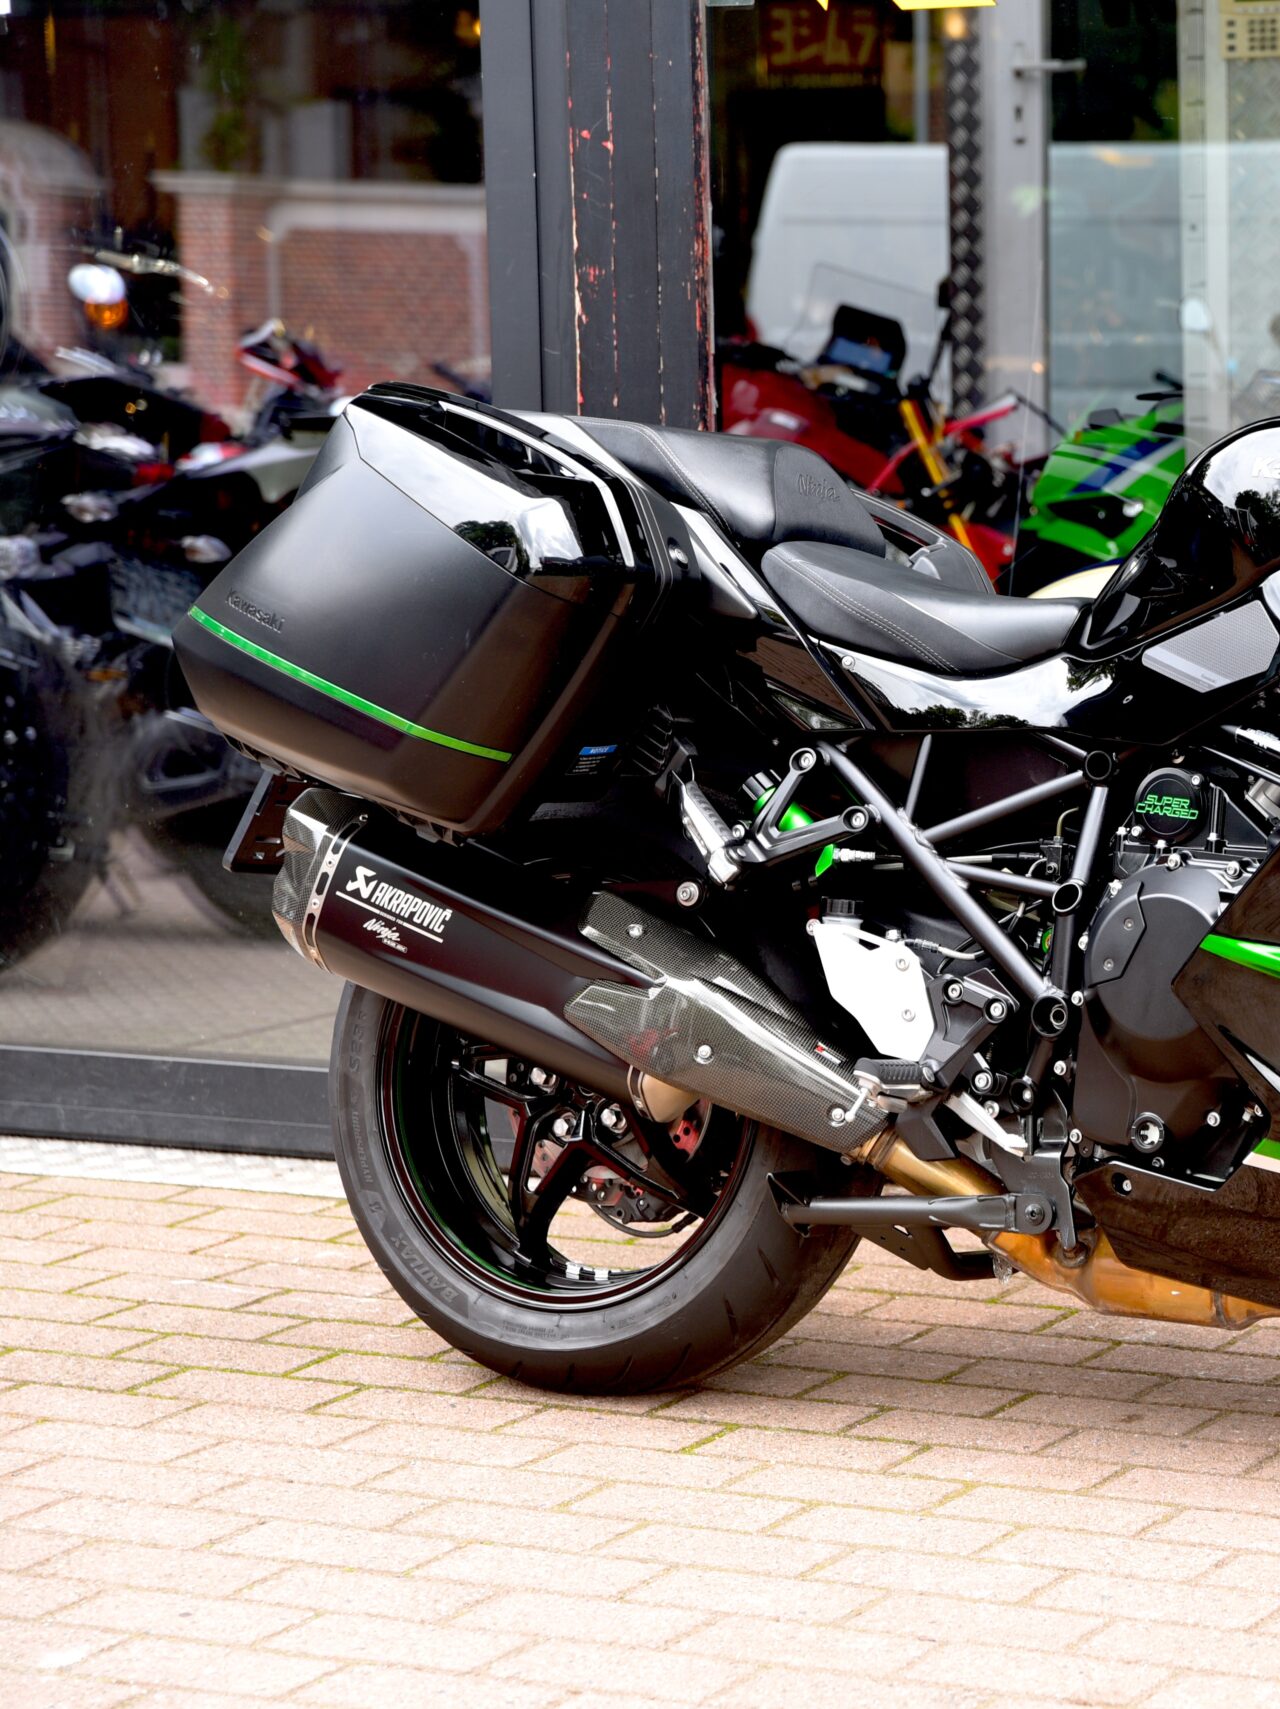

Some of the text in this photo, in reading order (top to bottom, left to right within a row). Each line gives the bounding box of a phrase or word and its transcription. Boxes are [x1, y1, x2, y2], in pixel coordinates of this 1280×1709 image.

[798, 473, 840, 503] Ninja
[225, 588, 285, 634] Kawasaki
[1135, 803, 1199, 820] CHARGED
[1145, 795, 1190, 809] SUPER
[370, 882, 453, 933] AKRAPOVIČ
[363, 918, 400, 941] Ninja
